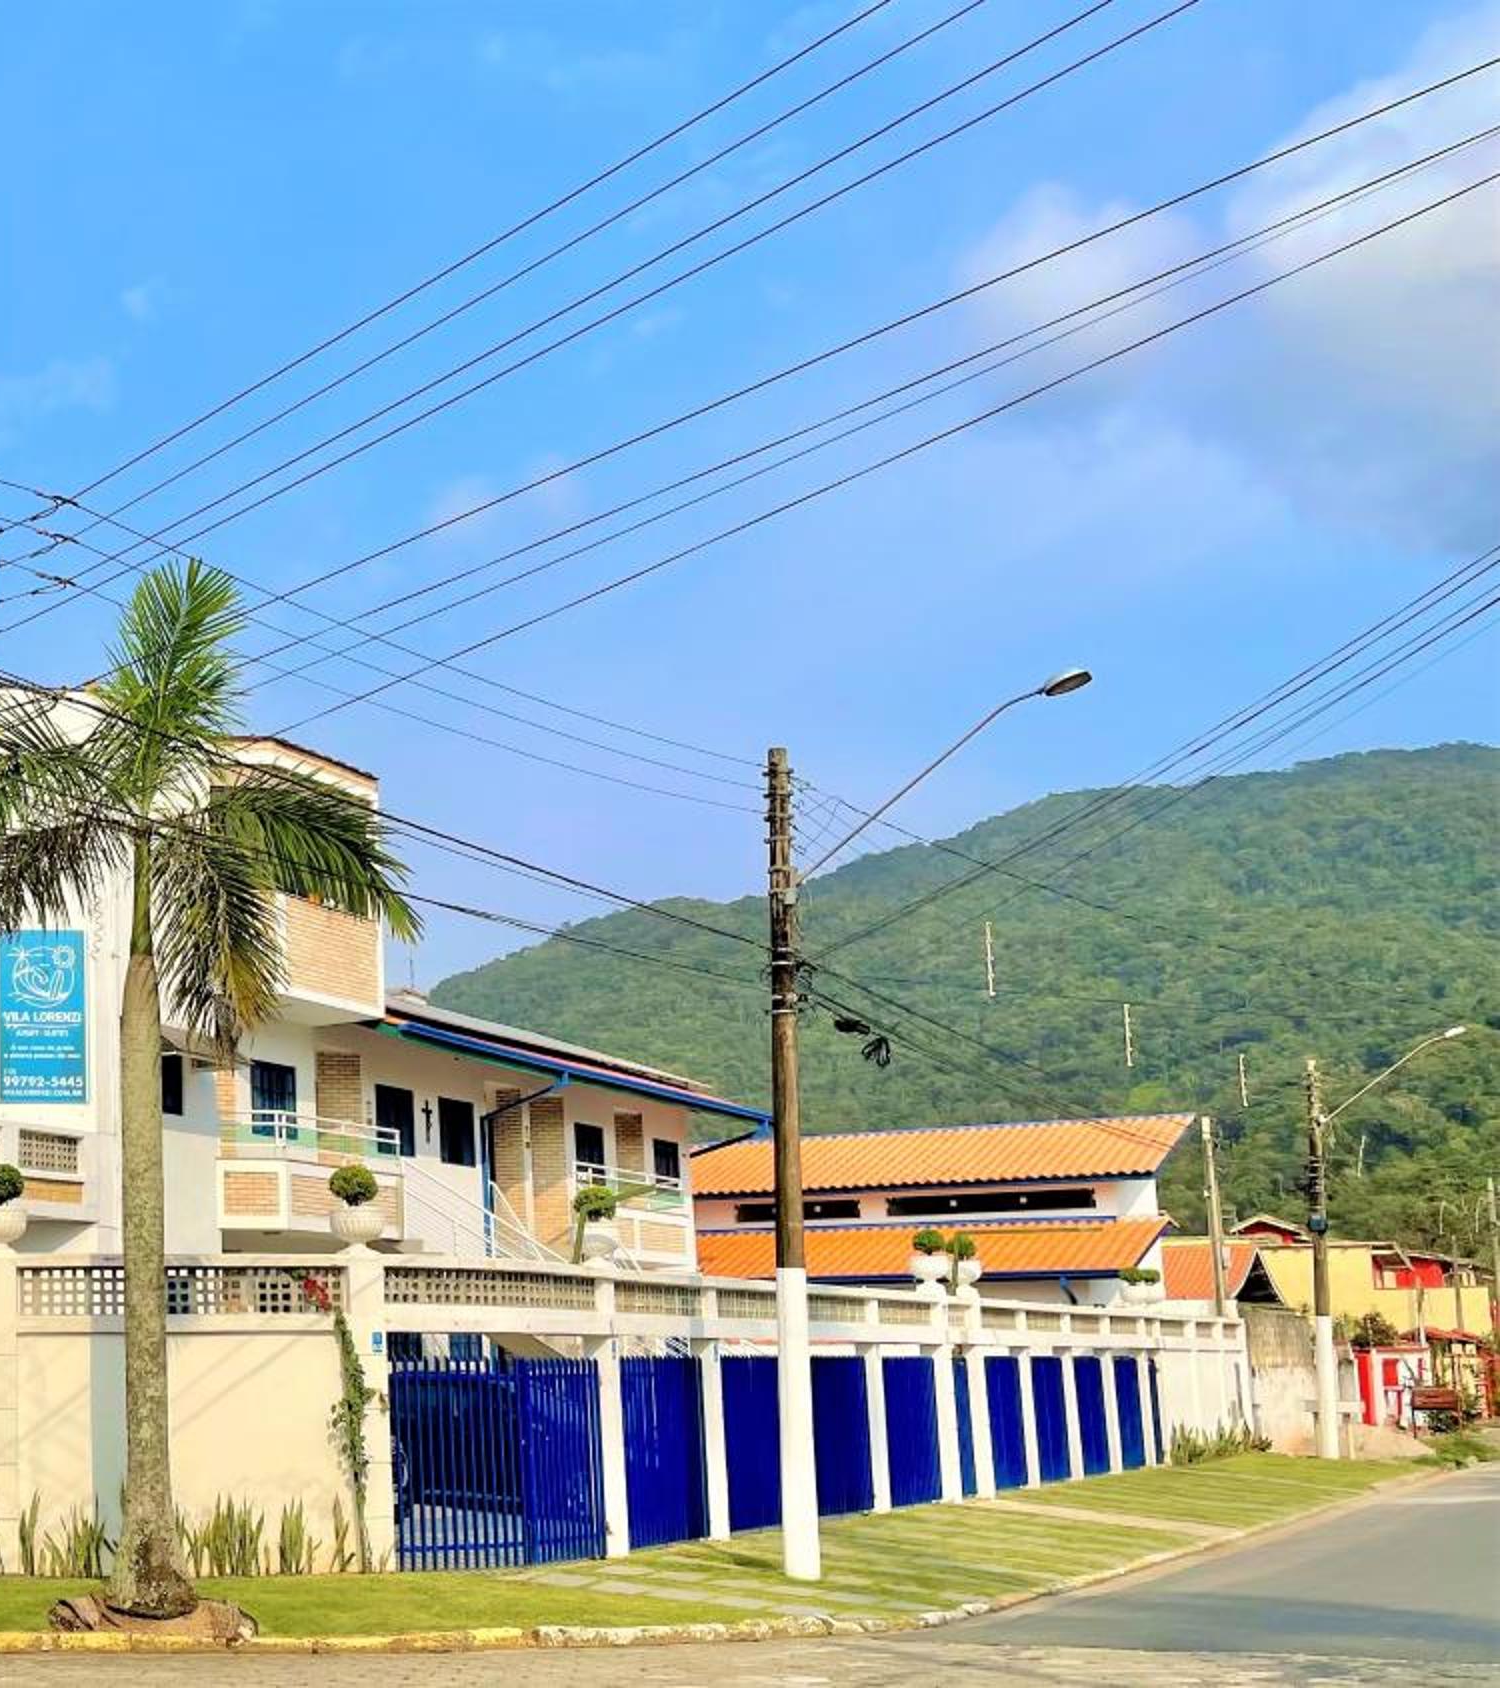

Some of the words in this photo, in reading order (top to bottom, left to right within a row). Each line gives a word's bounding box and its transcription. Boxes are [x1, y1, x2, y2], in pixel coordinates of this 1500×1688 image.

[3, 1011, 30, 1022] VILA
[33, 1011, 81, 1022] LORENZI
[3, 1075, 84, 1088] 99792-5445
